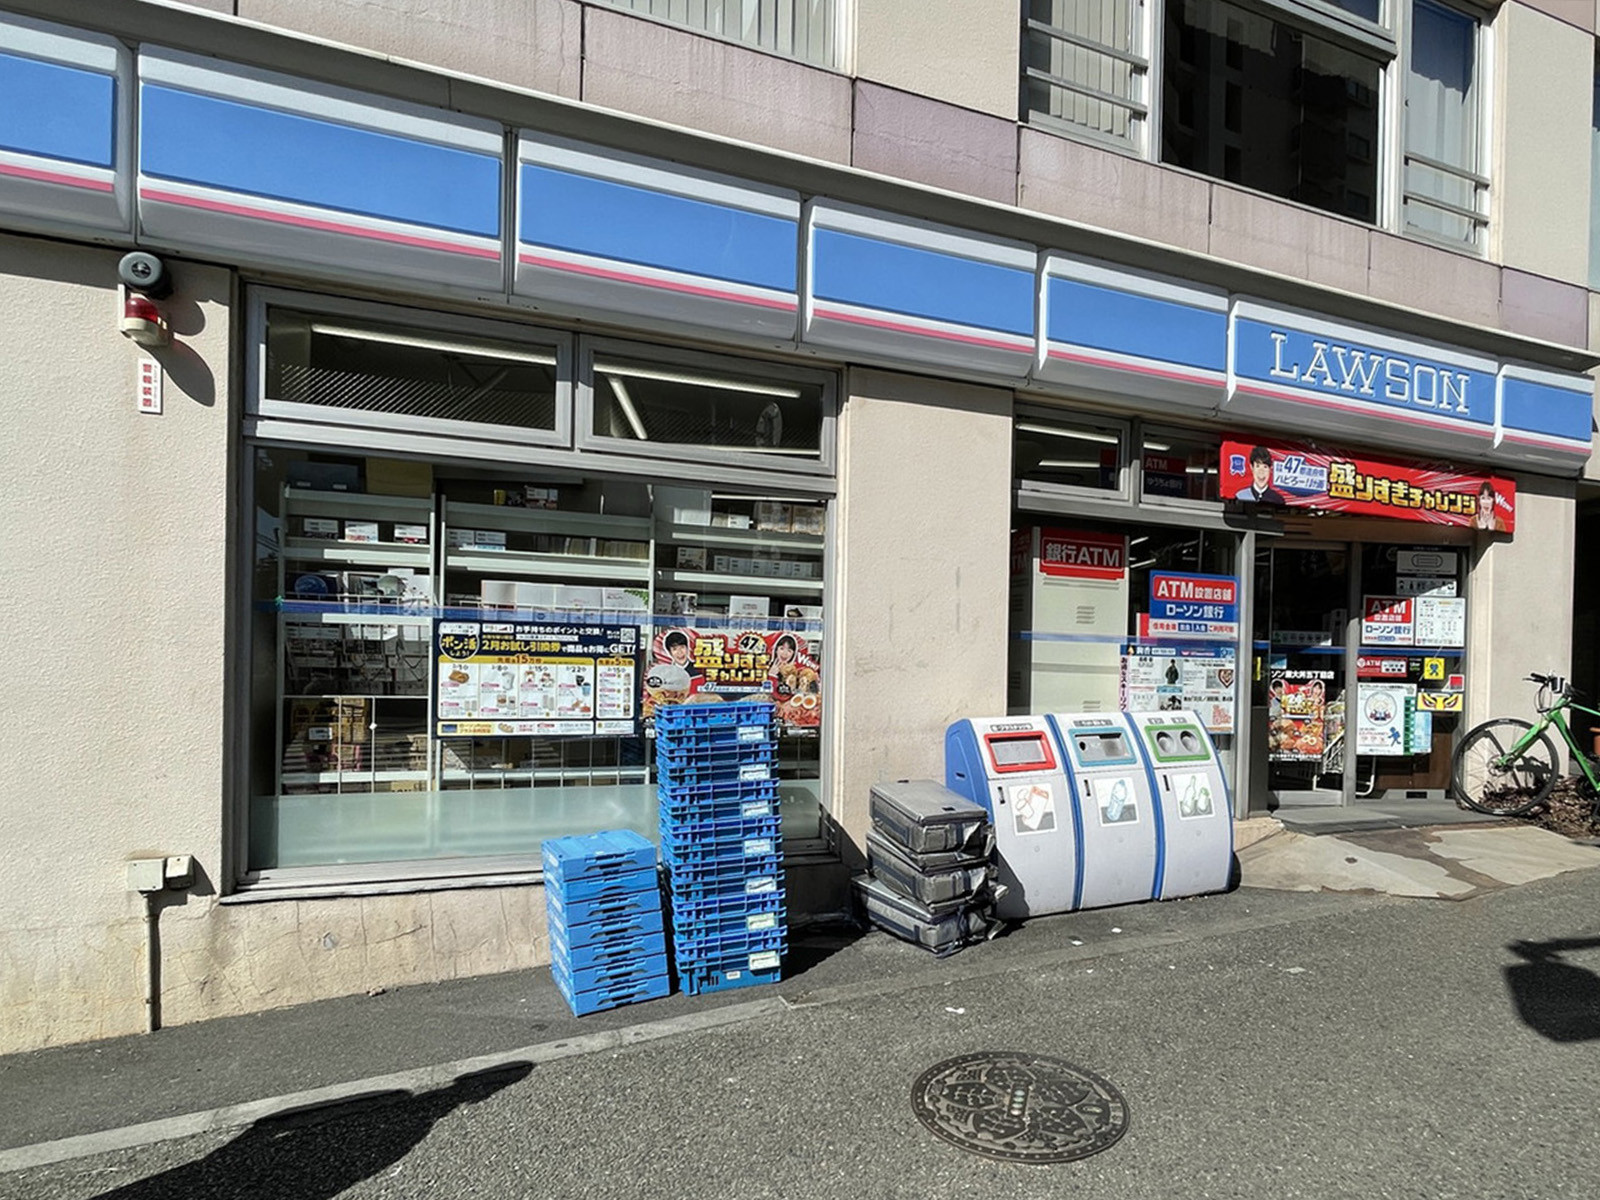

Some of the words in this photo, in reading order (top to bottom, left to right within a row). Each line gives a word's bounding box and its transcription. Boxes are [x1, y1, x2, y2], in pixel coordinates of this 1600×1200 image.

[1270, 331, 1470, 414] LAWSON
[1145, 458, 1168, 471] ATM
[1328, 462, 1476, 515] 盛りすぎチャレンジ
[1046, 543, 1120, 567] 銀行ATM
[1166, 603, 1225, 619] ローソン銀行
[1371, 600, 1407, 614] ATM
[1365, 625, 1411, 635] ローソン銀行
[693, 637, 771, 669] 盛りすぎ
[705, 669, 769, 682] チャレンジ
